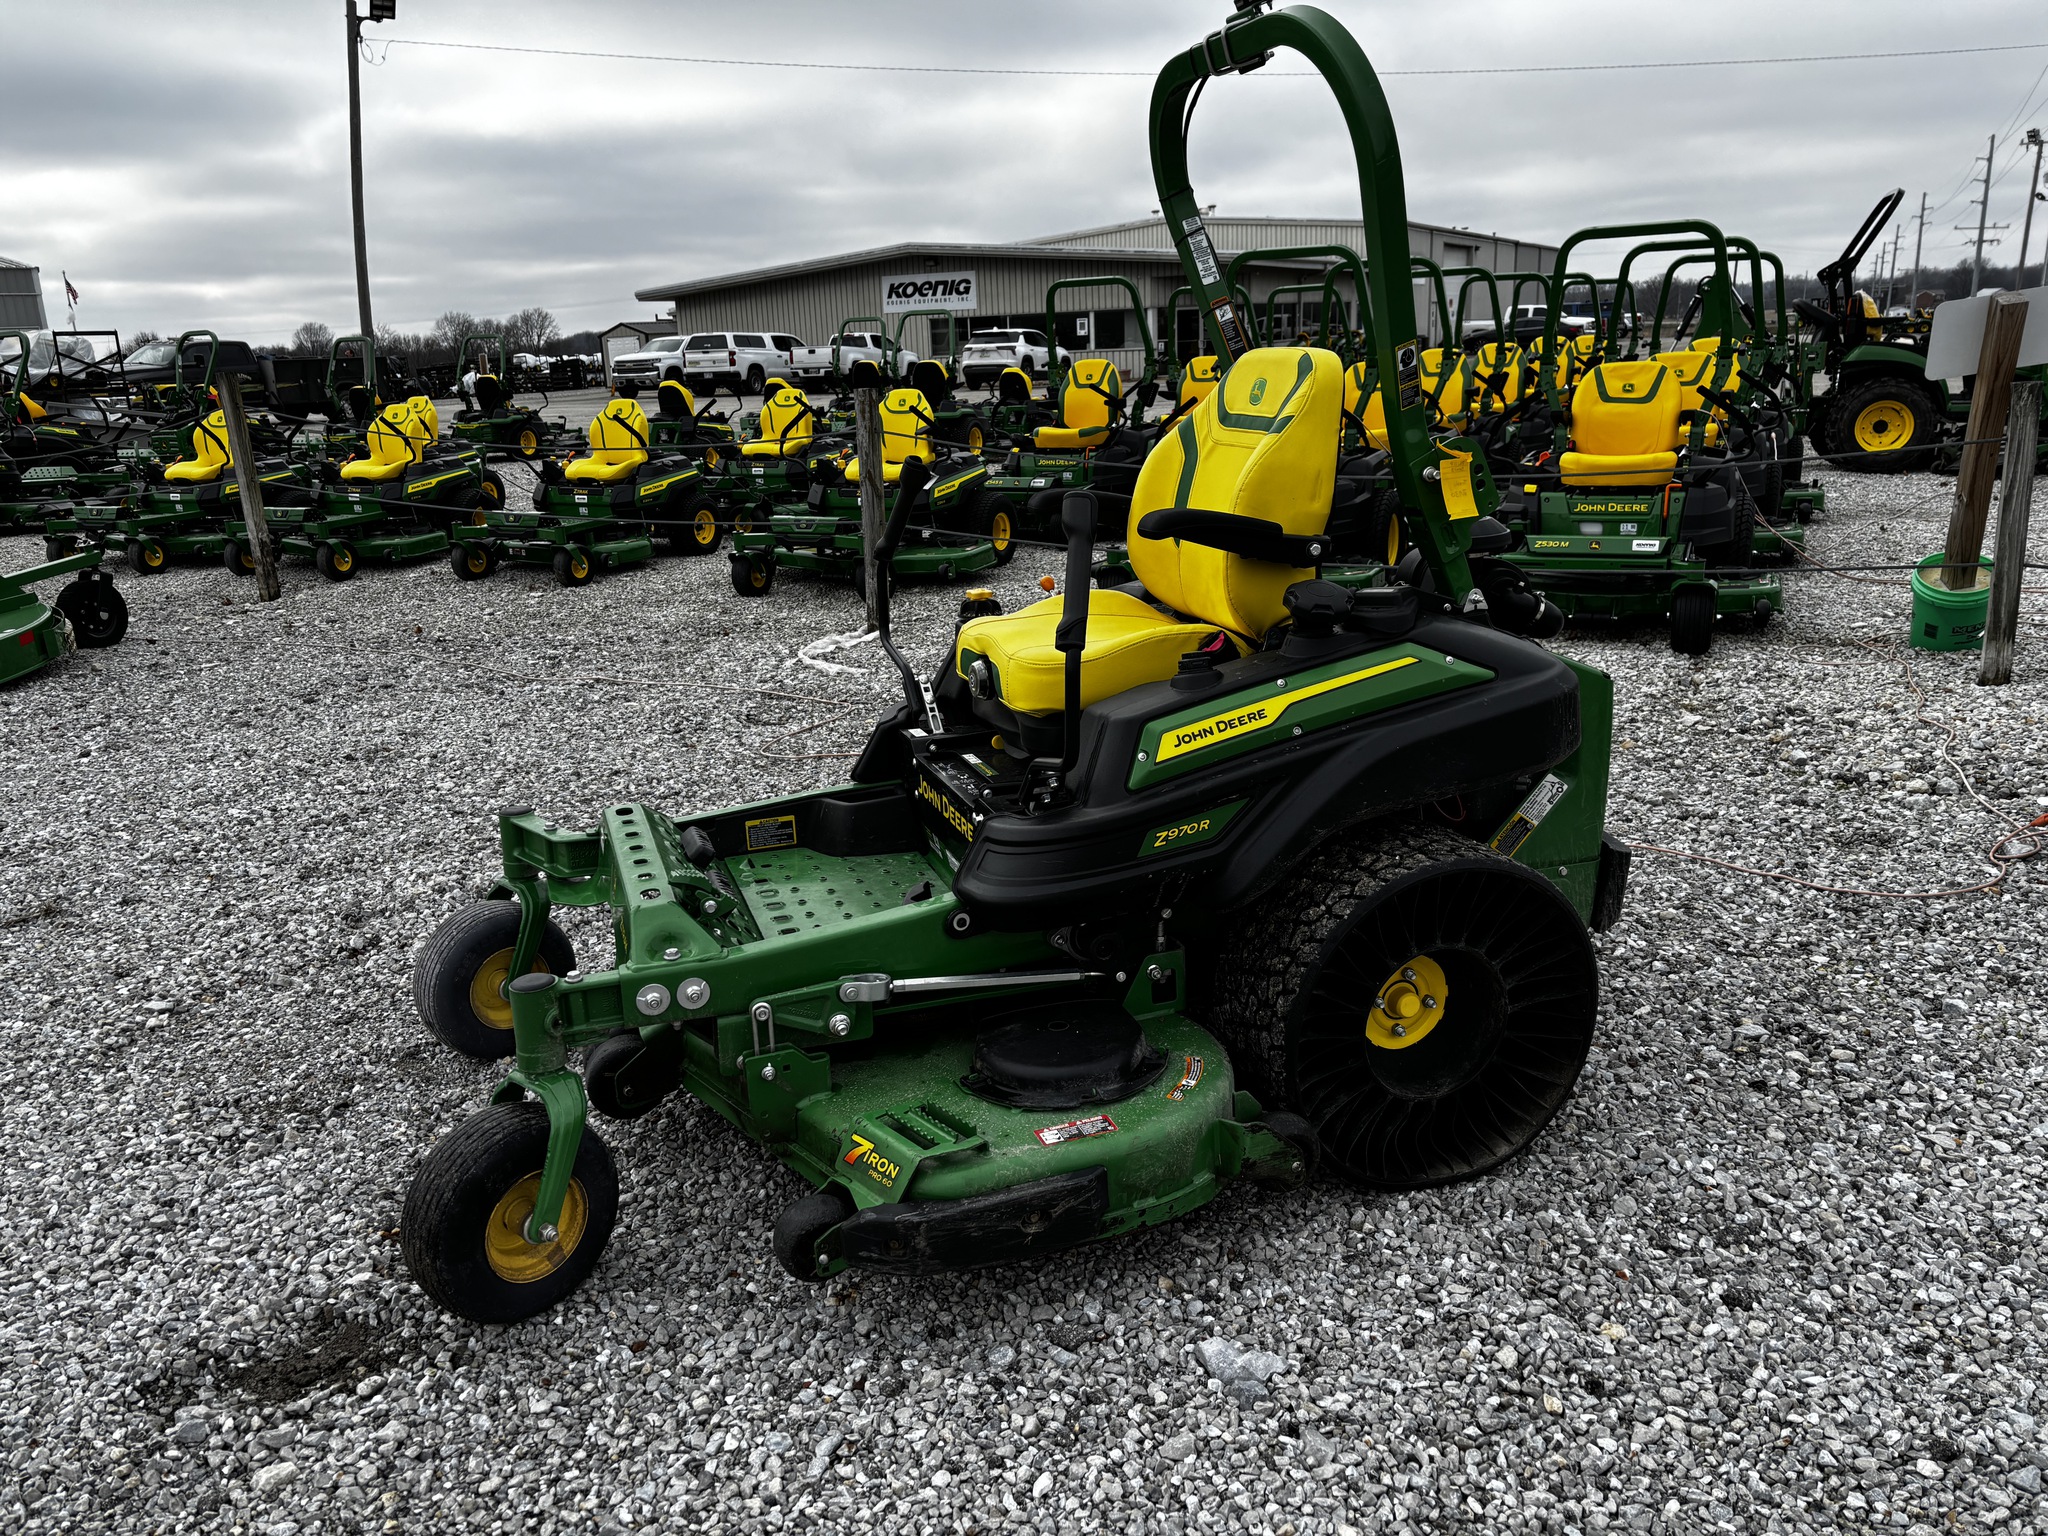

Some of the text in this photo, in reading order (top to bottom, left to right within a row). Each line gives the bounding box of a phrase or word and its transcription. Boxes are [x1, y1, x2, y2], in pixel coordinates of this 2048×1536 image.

[1574, 503, 1648, 512] JOHN DEERE
[1173, 708, 1268, 748] JOHN DEERE
[918, 774, 974, 842] JOHN DEERE
[844, 1133, 900, 1179] 7 IRON
[868, 1169, 893, 1188] PRO 60
